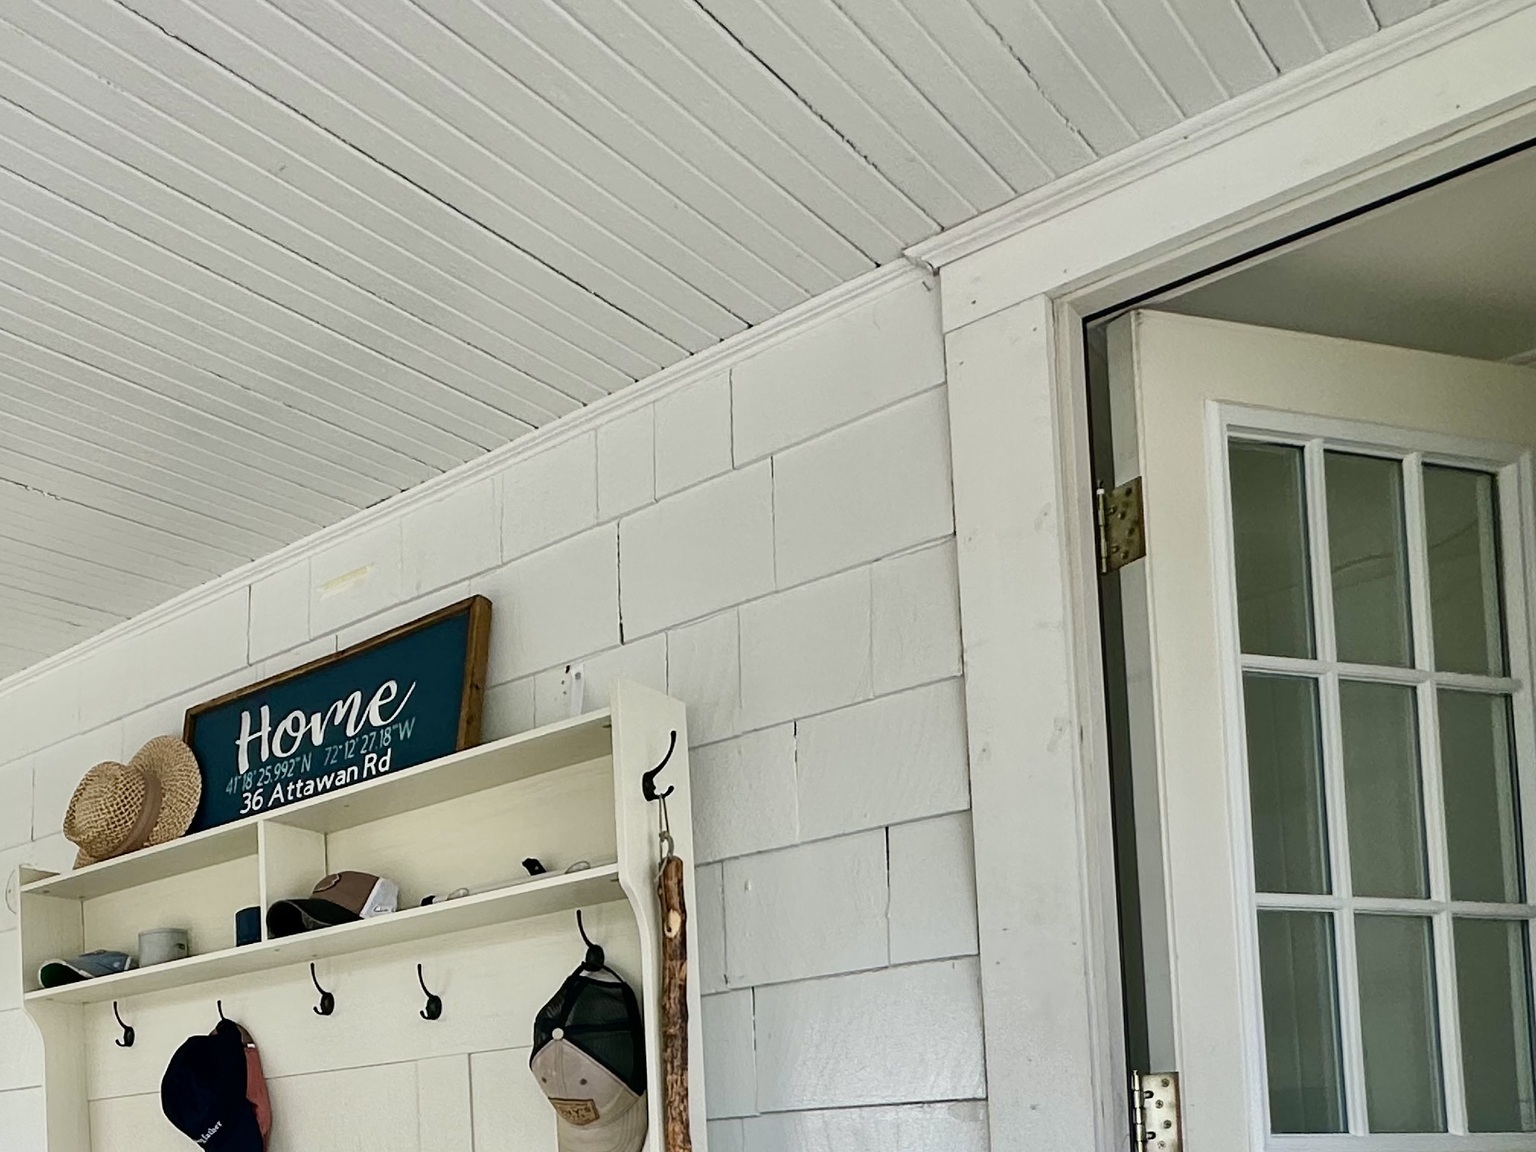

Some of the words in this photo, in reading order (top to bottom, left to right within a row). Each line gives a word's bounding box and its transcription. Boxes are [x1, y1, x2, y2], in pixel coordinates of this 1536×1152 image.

[235, 679, 417, 774] Home
[239, 791, 264, 814] 36
[267, 763, 359, 807] Attawan
[363, 748, 392, 779] Rd
